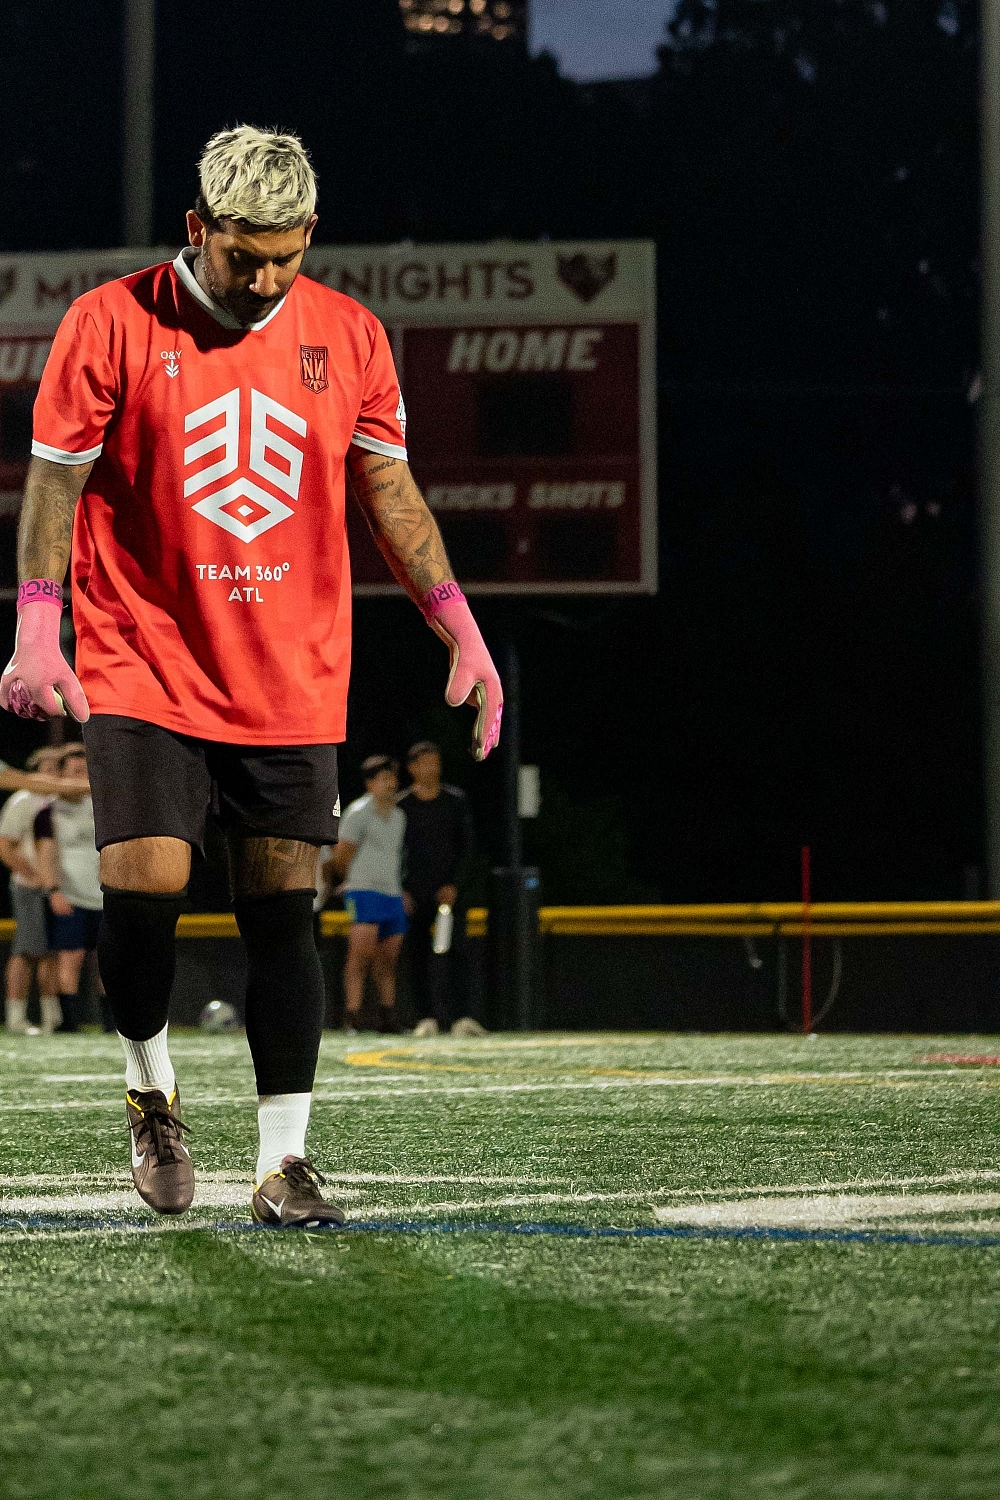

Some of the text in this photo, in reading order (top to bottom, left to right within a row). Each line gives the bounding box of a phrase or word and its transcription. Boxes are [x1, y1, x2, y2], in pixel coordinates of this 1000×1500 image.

[160, 350, 182, 360] O&Y
[449, 329, 604, 373] HOME
[195, 564, 251, 581] TEAM
[228, 587, 263, 602] ATL
